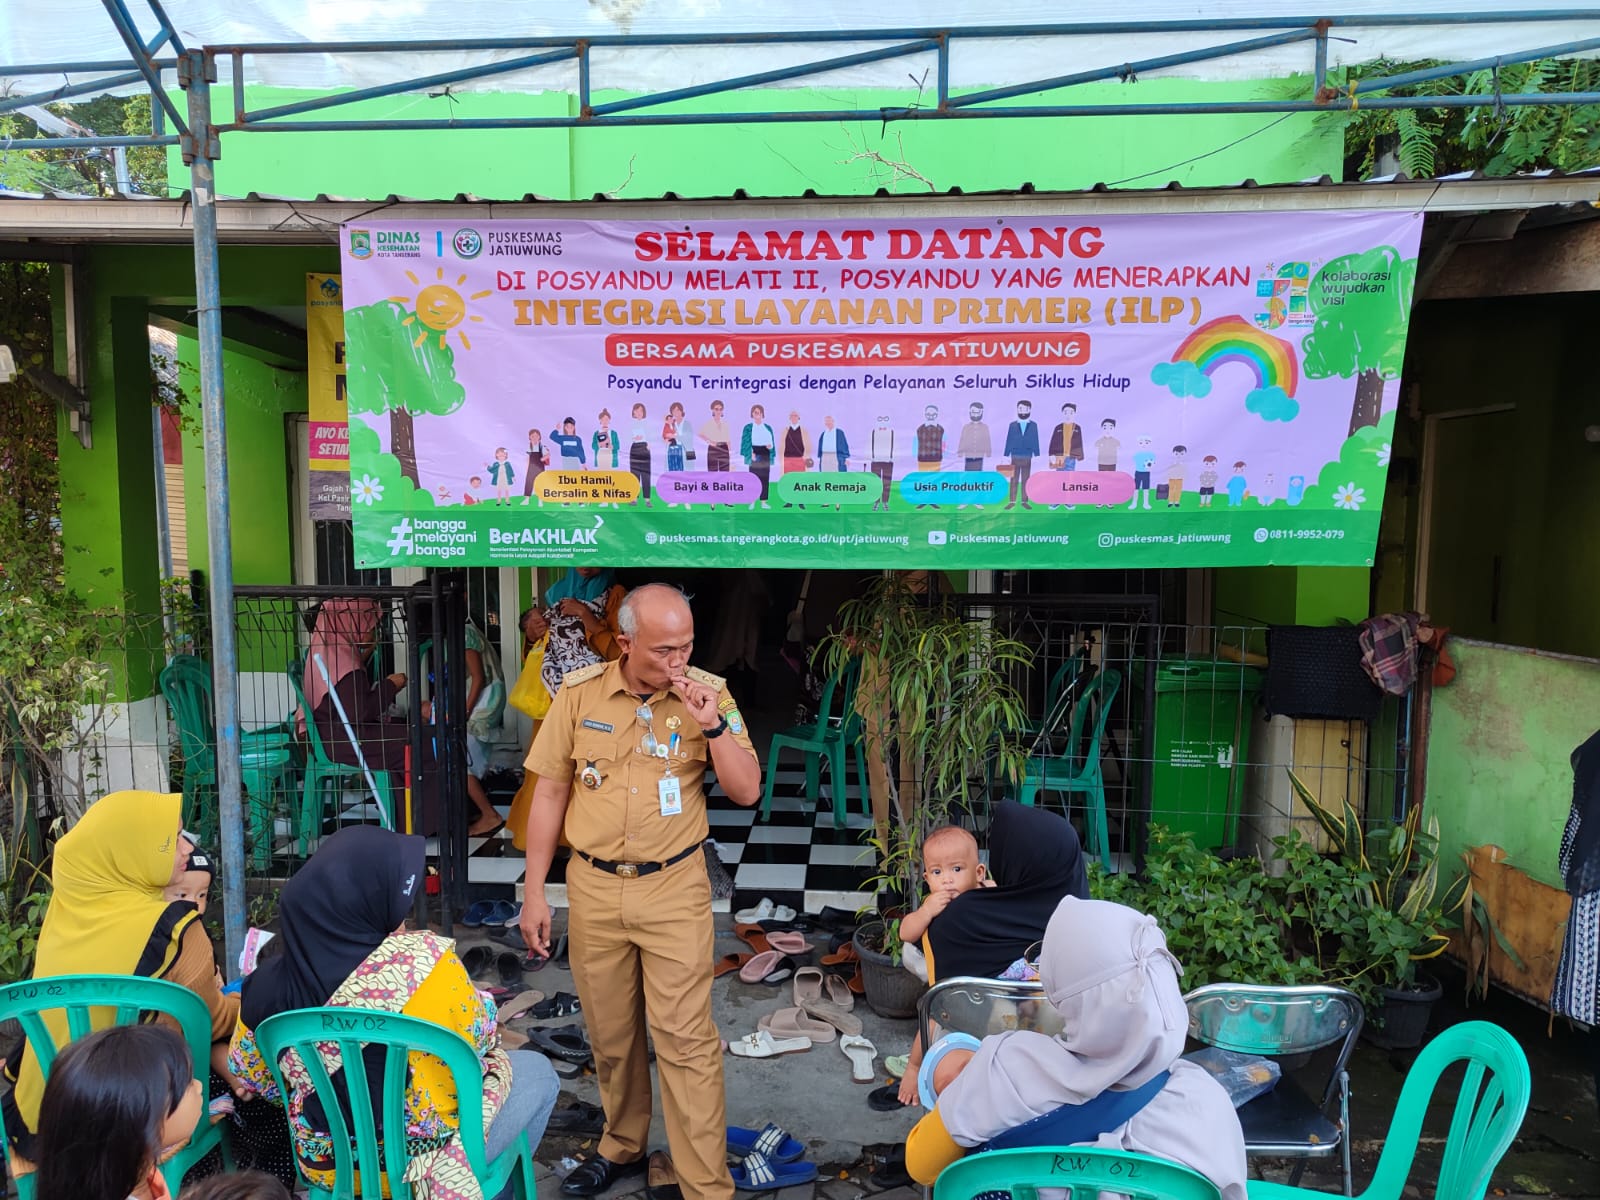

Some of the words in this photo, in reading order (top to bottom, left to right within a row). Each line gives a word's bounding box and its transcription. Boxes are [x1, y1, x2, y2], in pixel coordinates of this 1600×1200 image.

[376, 231, 421, 244] DINAS
[488, 232, 563, 243] PUSKESMAS
[489, 245, 563, 256] JATIUWUNG
[634, 230, 874, 262] SELAMAT
[886, 227, 1105, 260] DATANG
[497, 270, 526, 291] DI
[537, 270, 673, 290] POSYANDU
[684, 269, 782, 290] MELATI
[793, 269, 828, 293] II,
[841, 268, 980, 291] POSYANDU
[991, 268, 1062, 289] YANG
[1073, 266, 1251, 288] MENERAPKAN
[1321, 271, 1392, 282] kolaborasi
[1321, 283, 1385, 295] wujudkan
[1321, 297, 1345, 306] visi
[513, 299, 726, 326] INTEGRASI
[735, 298, 922, 326] LAYANAN
[933, 297, 1092, 324] PRIMER
[1104, 296, 1202, 326] (ILP)
[616, 342, 735, 360] BERSAMA
[747, 341, 902, 360] PUSKESMAS
[913, 340, 1081, 359] JATIUWUNG
[607, 373, 682, 394] Posyandu
[690, 374, 791, 393] Terintegrasi
[800, 373, 856, 393] dengan
[863, 374, 946, 392] Pelayanan
[953, 373, 1017, 390] Seluruh
[1025, 374, 1075, 389] Siklus
[1083, 373, 1131, 393] Hidup
[315, 426, 336, 439] AYO
[558, 475, 577, 485] Ibu
[581, 475, 616, 487] Hamil,
[674, 481, 698, 493] Bayi
[701, 482, 709, 491] &
[712, 481, 744, 492] Balita
[914, 482, 938, 492] Usia
[942, 481, 995, 492] Produktif
[1062, 482, 1099, 492] Lansia
[543, 488, 588, 498] Bersalin
[592, 489, 599, 498] &
[603, 489, 631, 499] Nifas
[793, 482, 822, 492] Anak
[825, 482, 867, 494] Remaja
[414, 518, 467, 532] bangga
[414, 531, 477, 545] melayani
[489, 528, 598, 545] BerAKHLAK
[659, 533, 909, 546] puskesmas.tangerangkota.go.id/upt/jatiuwung
[949, 533, 1010, 543] Puskesmas
[1012, 533, 1069, 545] Jatiuwung
[1114, 533, 1231, 546] puskesmas_jatiuwung
[1269, 530, 1345, 539] 0811-9952-079
[415, 545, 466, 559] bangsa
[321, 1014, 358, 1032] RW
[363, 1016, 390, 1031] 02
[1050, 1154, 1091, 1174] RW
[1109, 1161, 1142, 1178] 02
